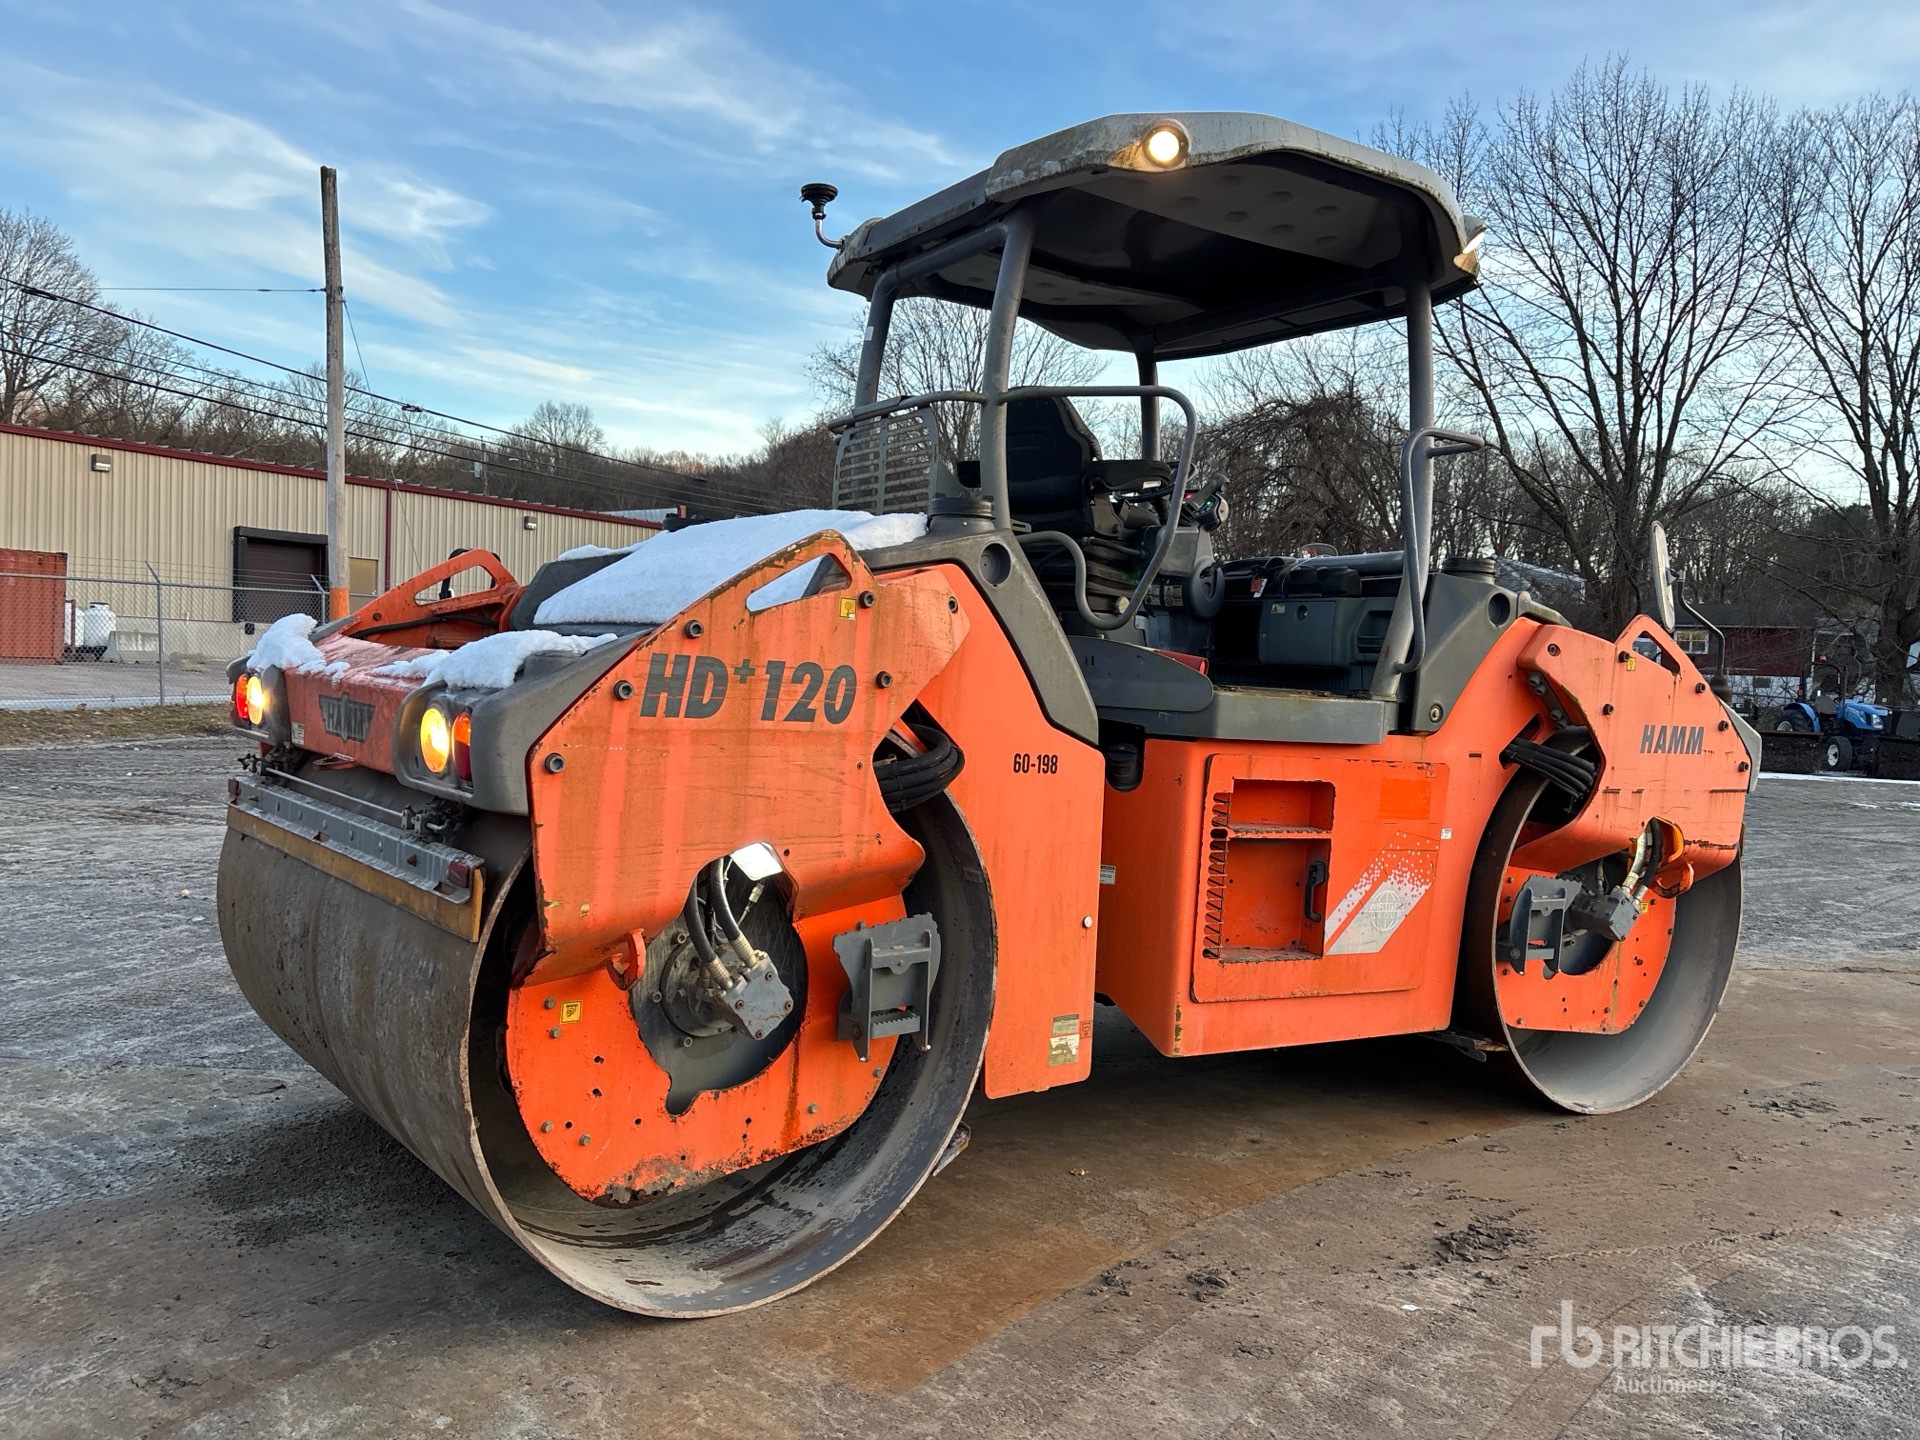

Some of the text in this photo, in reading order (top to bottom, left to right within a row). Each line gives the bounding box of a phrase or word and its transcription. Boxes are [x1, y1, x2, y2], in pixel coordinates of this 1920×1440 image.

[761, 660, 858, 724] 120
[1639, 724, 1705, 754] HAMM
[1013, 753, 1058, 774] 60-198
